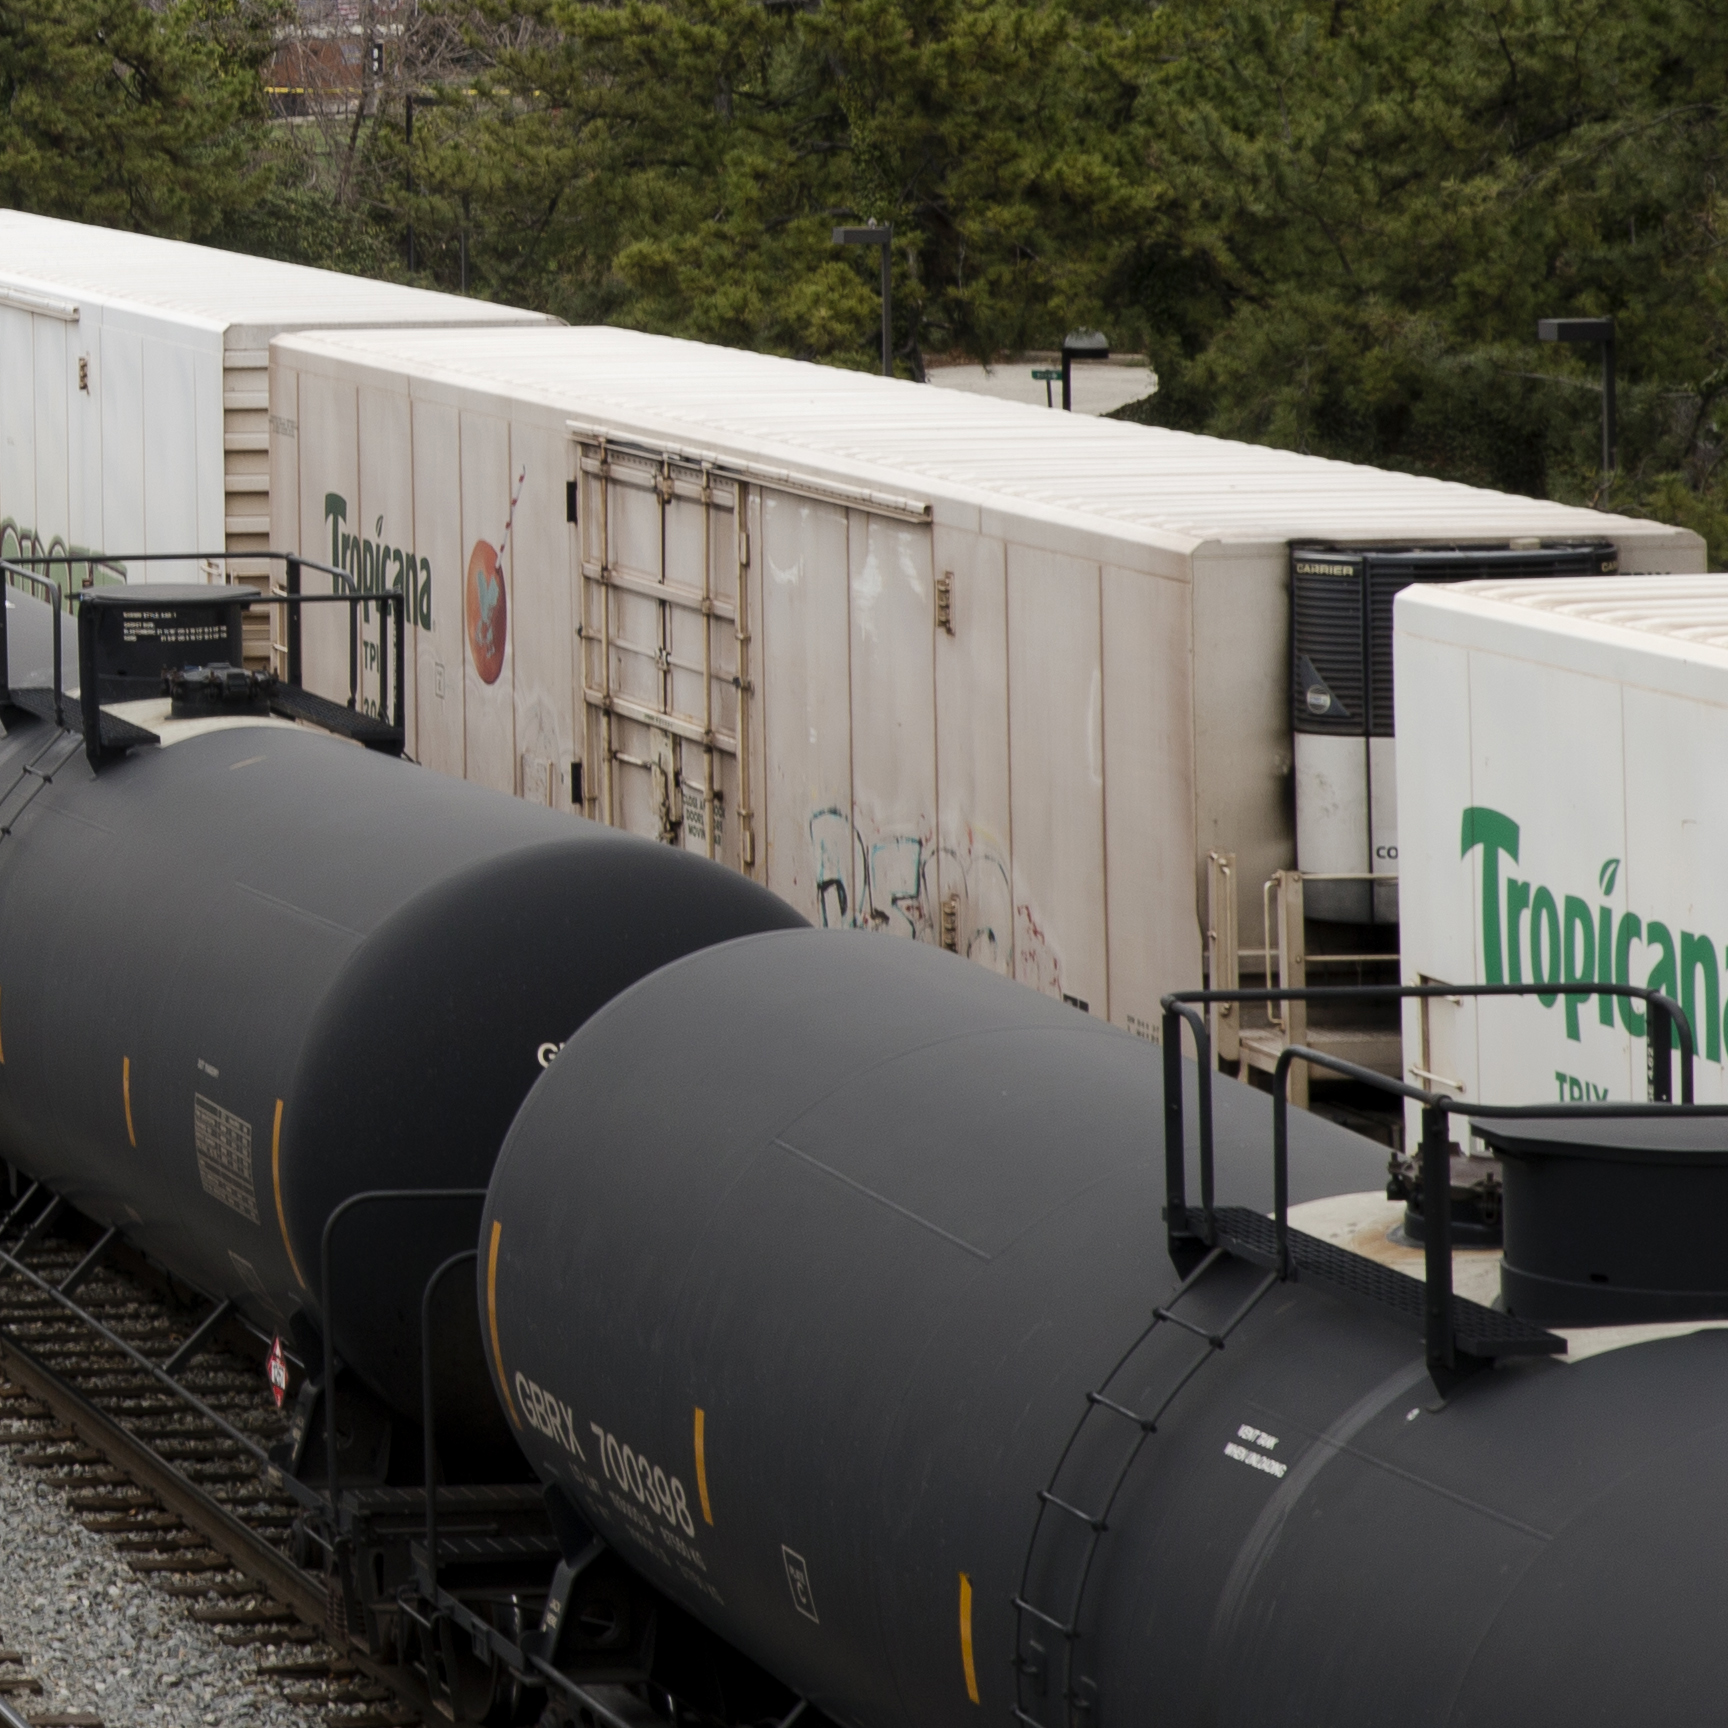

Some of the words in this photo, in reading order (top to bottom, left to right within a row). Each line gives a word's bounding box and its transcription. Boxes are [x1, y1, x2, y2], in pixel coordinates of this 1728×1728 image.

[324, 492, 432, 632] Tropicana
[1295, 562, 1354, 576] CARRIER
[362, 639, 381, 674] TPI
[1460, 805, 1728, 1065] Tropican
[514, 1370, 587, 1463] GBRX
[589, 1420, 695, 1538] 700398
